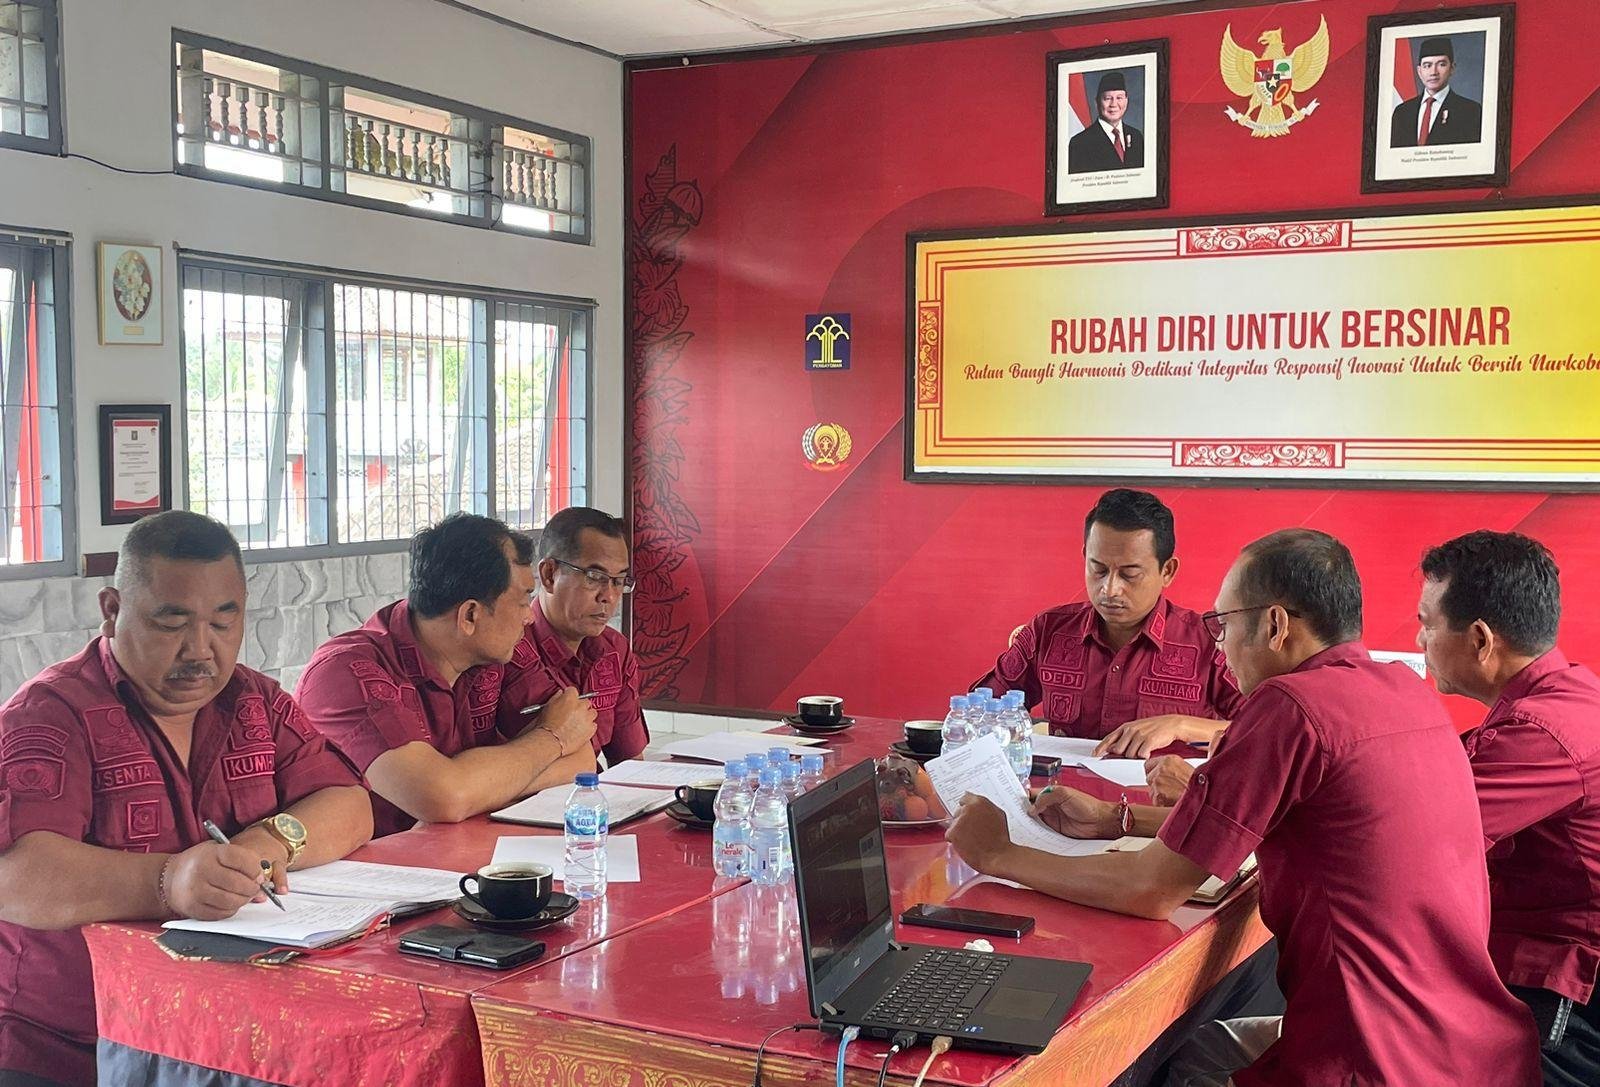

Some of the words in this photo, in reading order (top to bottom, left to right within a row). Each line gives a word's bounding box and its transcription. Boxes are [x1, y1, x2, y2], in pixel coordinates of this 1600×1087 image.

[1050, 317, 1147, 354] RUBAH
[1157, 315, 1216, 352] DIRI
[1226, 311, 1331, 351] UNTUK
[1341, 306, 1510, 348] BERSINAR
[963, 364, 1003, 380] Rutan
[1009, 362, 1055, 384] Bangli
[1059, 361, 1126, 379] Harmonis
[1131, 360, 1193, 377] Dedikasi
[1197, 359, 1269, 382] Integritas
[1273, 357, 1344, 381] Responsif
[1347, 356, 1405, 374] Inovasi
[1409, 355, 1462, 373] Untuk
[1468, 354, 1522, 373] Bersih
[1042, 671, 1083, 687] DEDI
[1142, 680, 1197, 698] KUMHAM
[229, 755, 275, 776] KUMH
[575, 818, 596, 826] AQUA
[721, 848, 743, 856] nerale
[725, 841, 735, 849] Le
